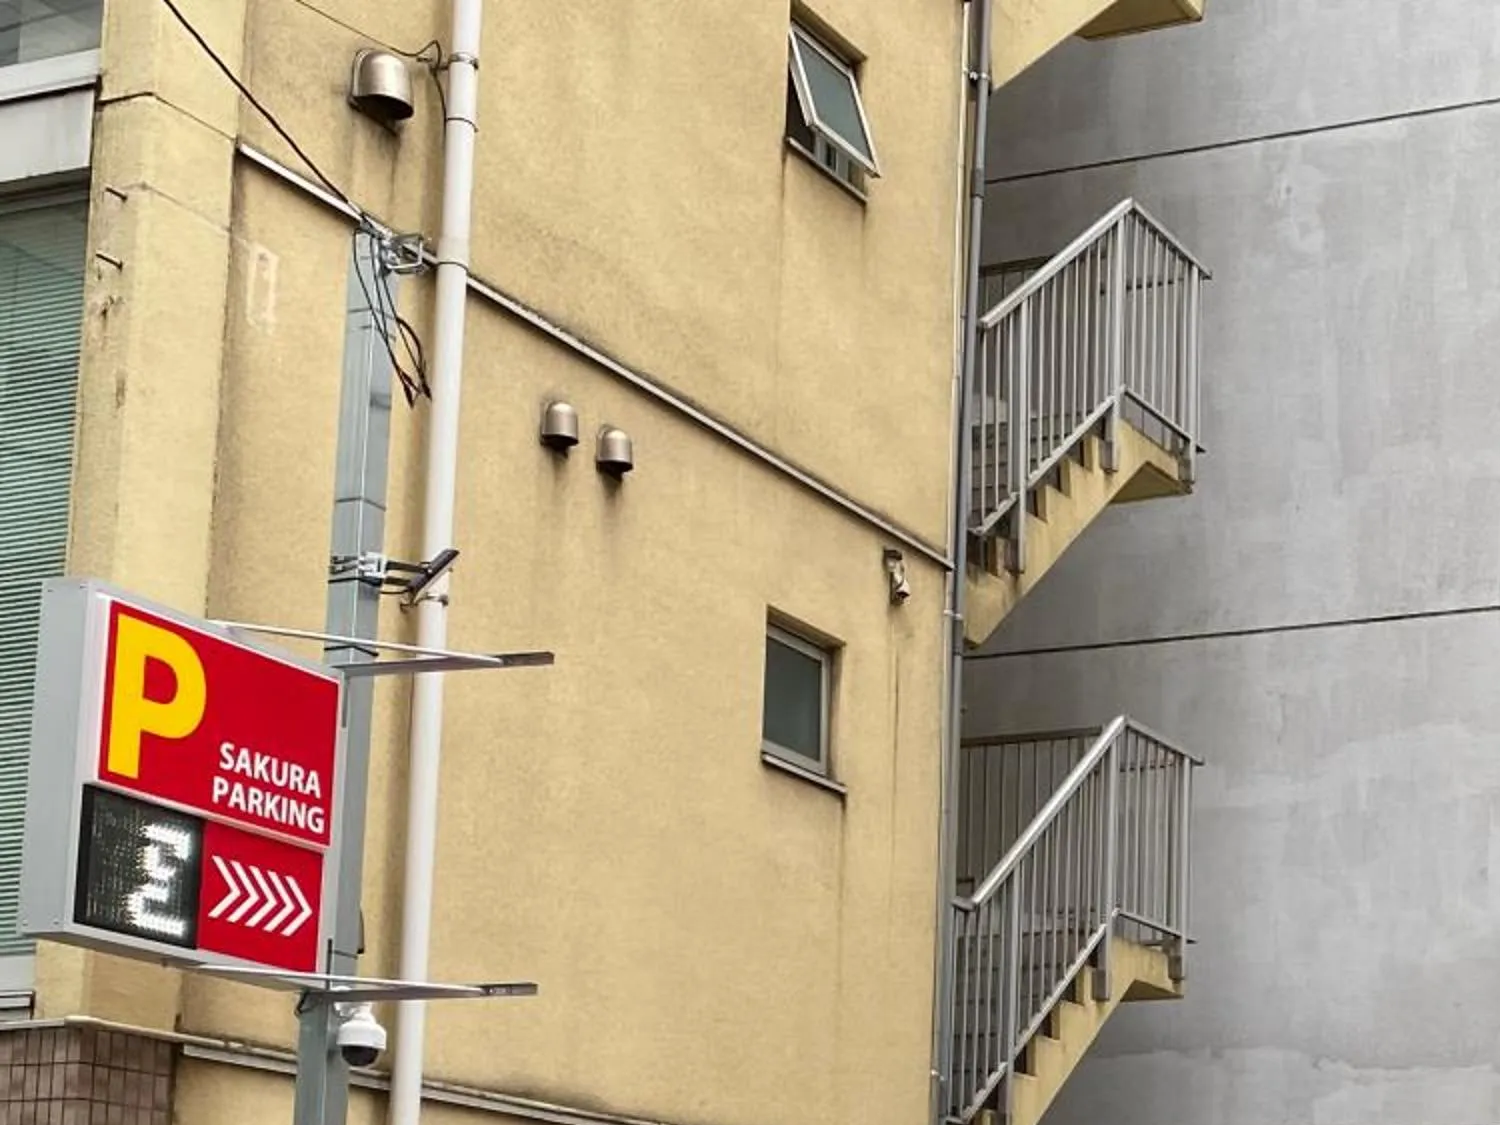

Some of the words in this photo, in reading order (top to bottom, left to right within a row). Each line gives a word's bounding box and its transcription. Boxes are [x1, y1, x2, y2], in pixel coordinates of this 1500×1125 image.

[107, 612, 207, 780] P
[219, 741, 321, 799] SAKURA
[211, 776, 325, 834] PARKING
